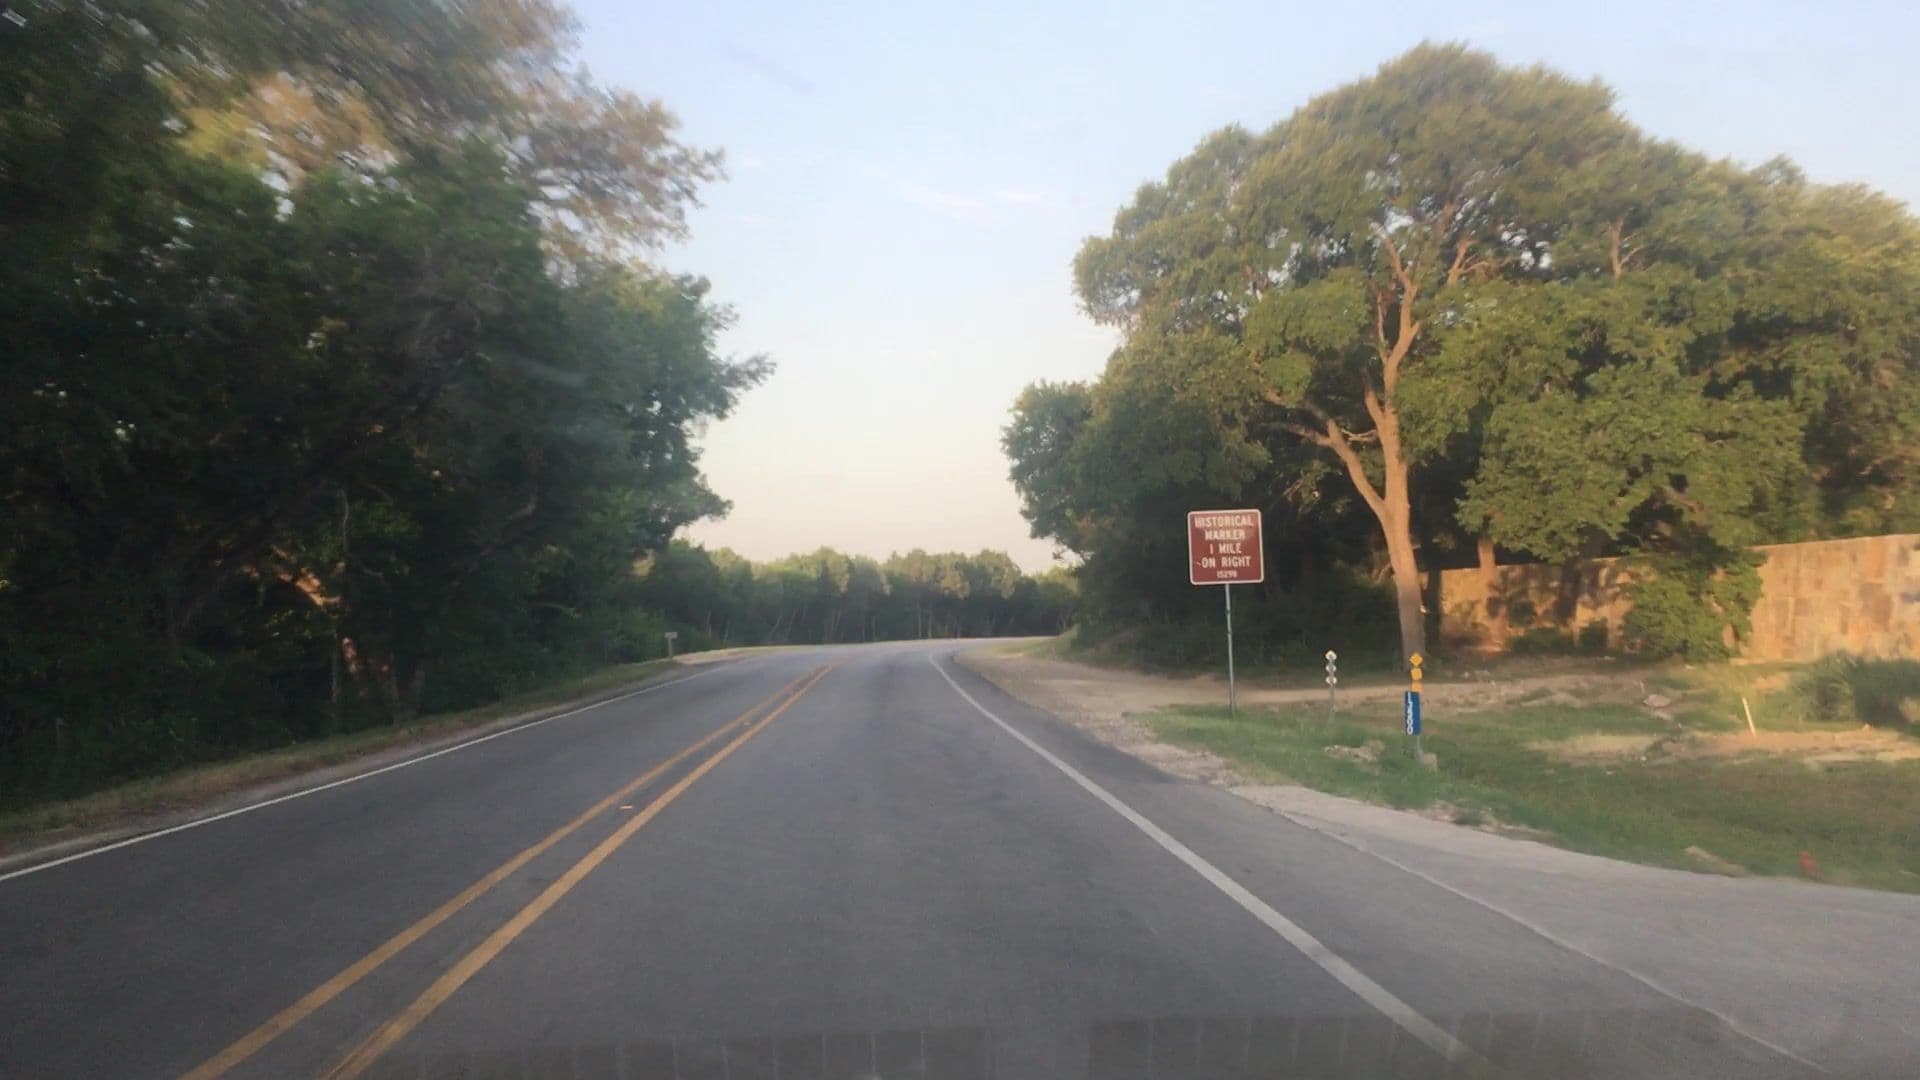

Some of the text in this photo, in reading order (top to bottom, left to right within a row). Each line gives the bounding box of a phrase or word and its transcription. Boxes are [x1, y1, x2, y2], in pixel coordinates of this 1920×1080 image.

[1194, 514, 1254, 528] HISTORICAL
[1204, 528, 1246, 541] MARKER
[1209, 542, 1242, 555] 1 MILE
[1201, 556, 1251, 568] ON RIGHT
